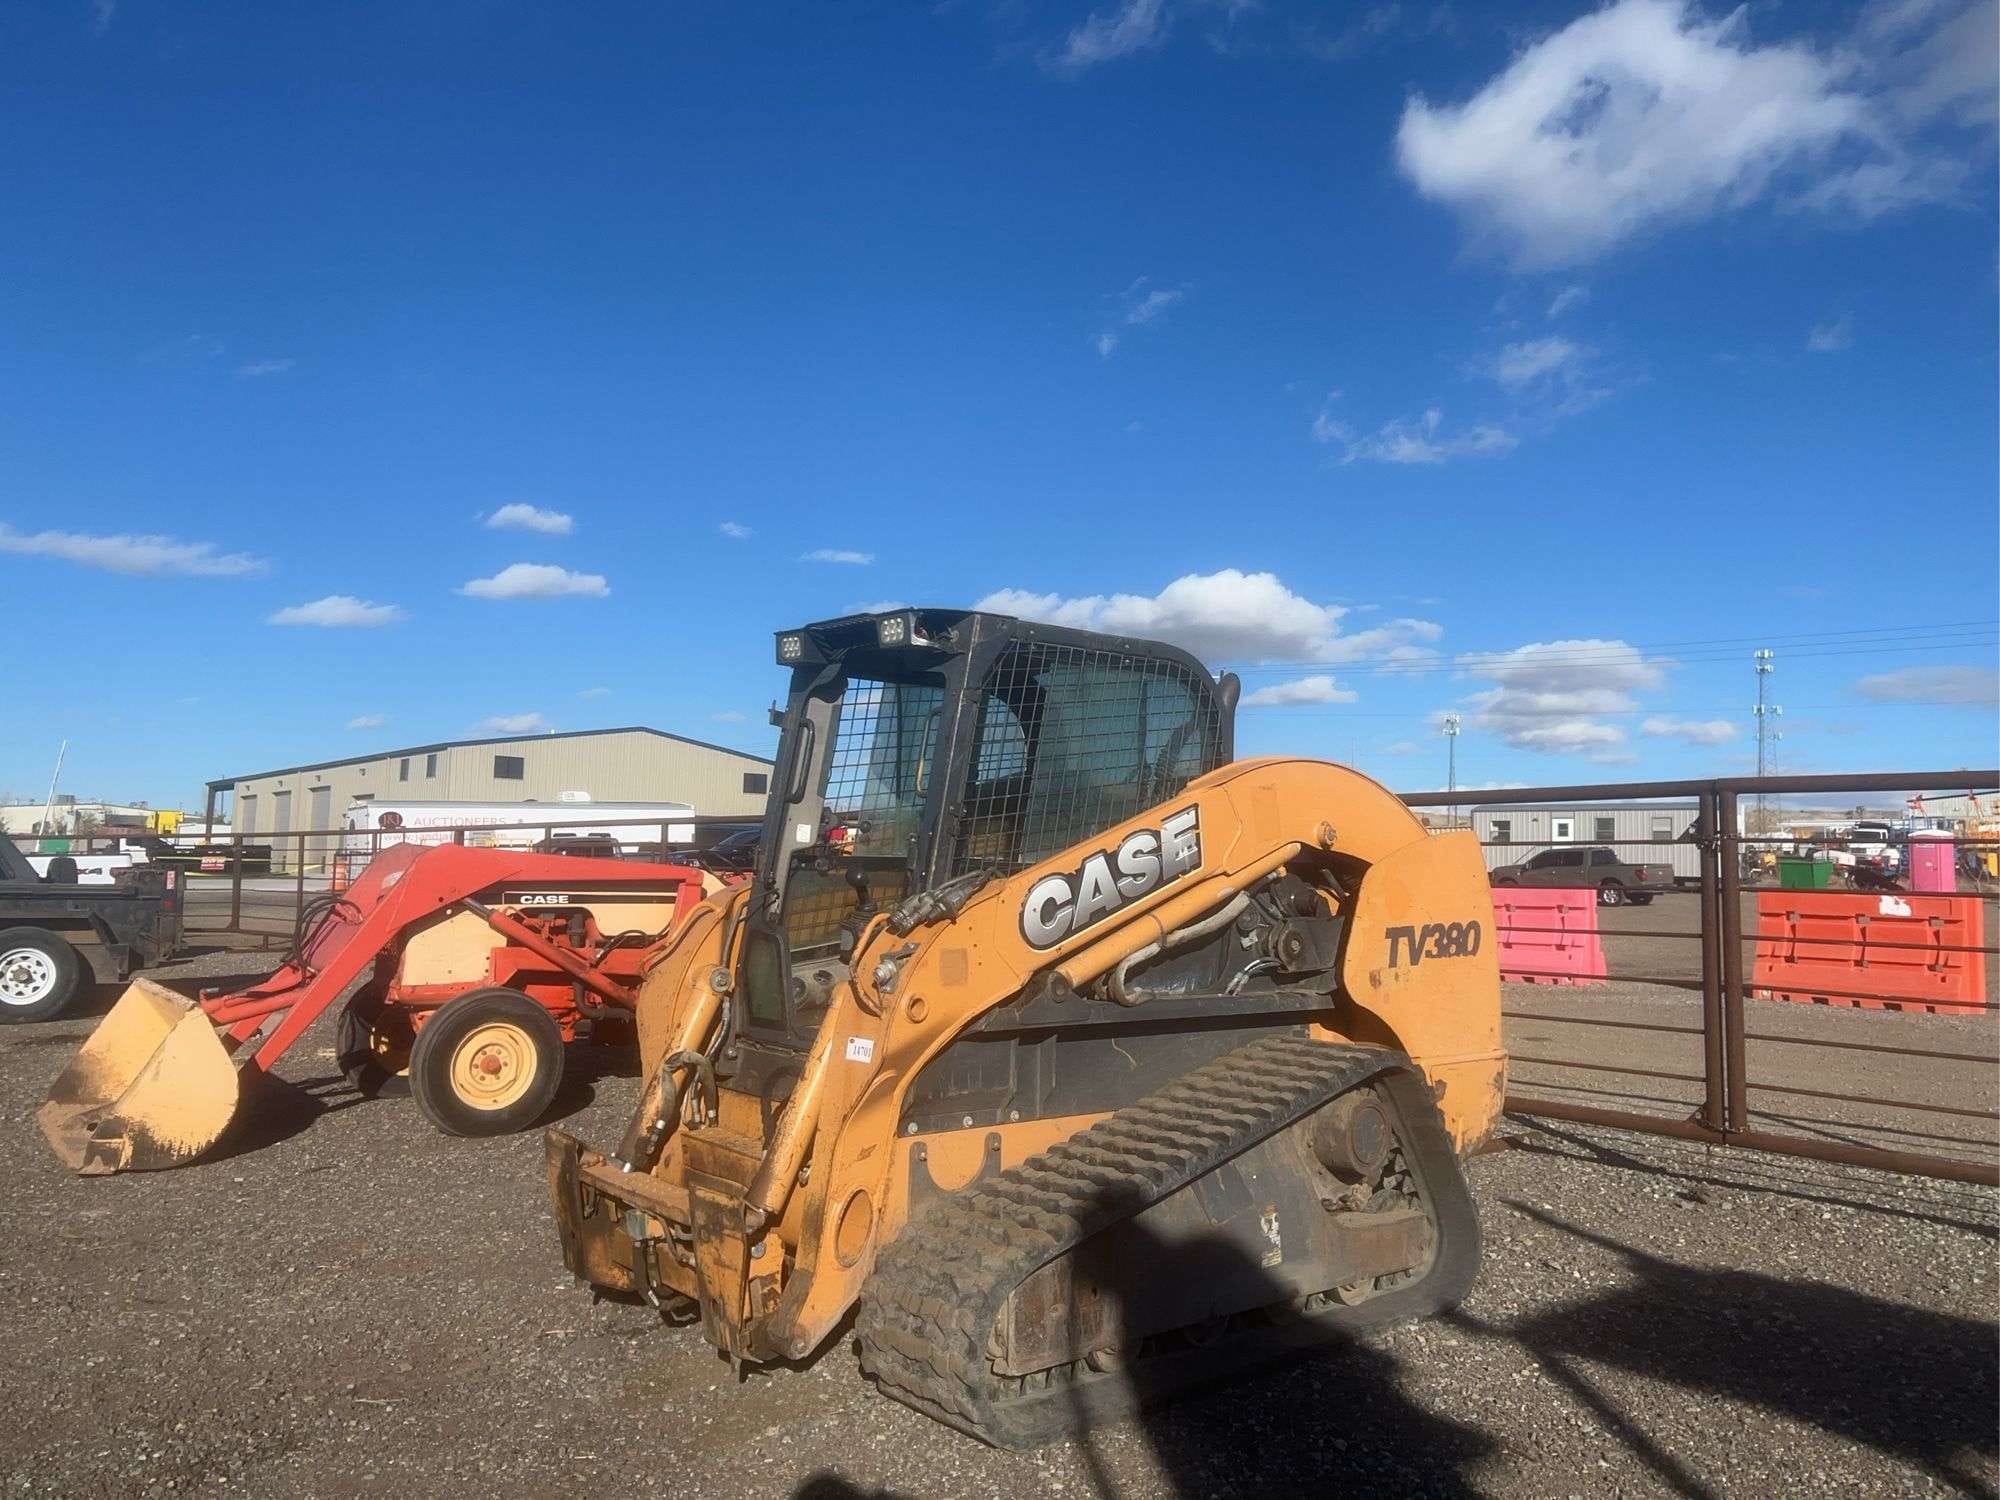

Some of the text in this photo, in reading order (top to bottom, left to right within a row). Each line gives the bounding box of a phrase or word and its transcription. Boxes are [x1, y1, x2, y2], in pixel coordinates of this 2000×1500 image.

[414, 816, 506, 827] AUCTIONEERS
[1021, 804, 1201, 949] CASE
[520, 895, 569, 904] CASE
[1385, 920, 1480, 968] TV380
